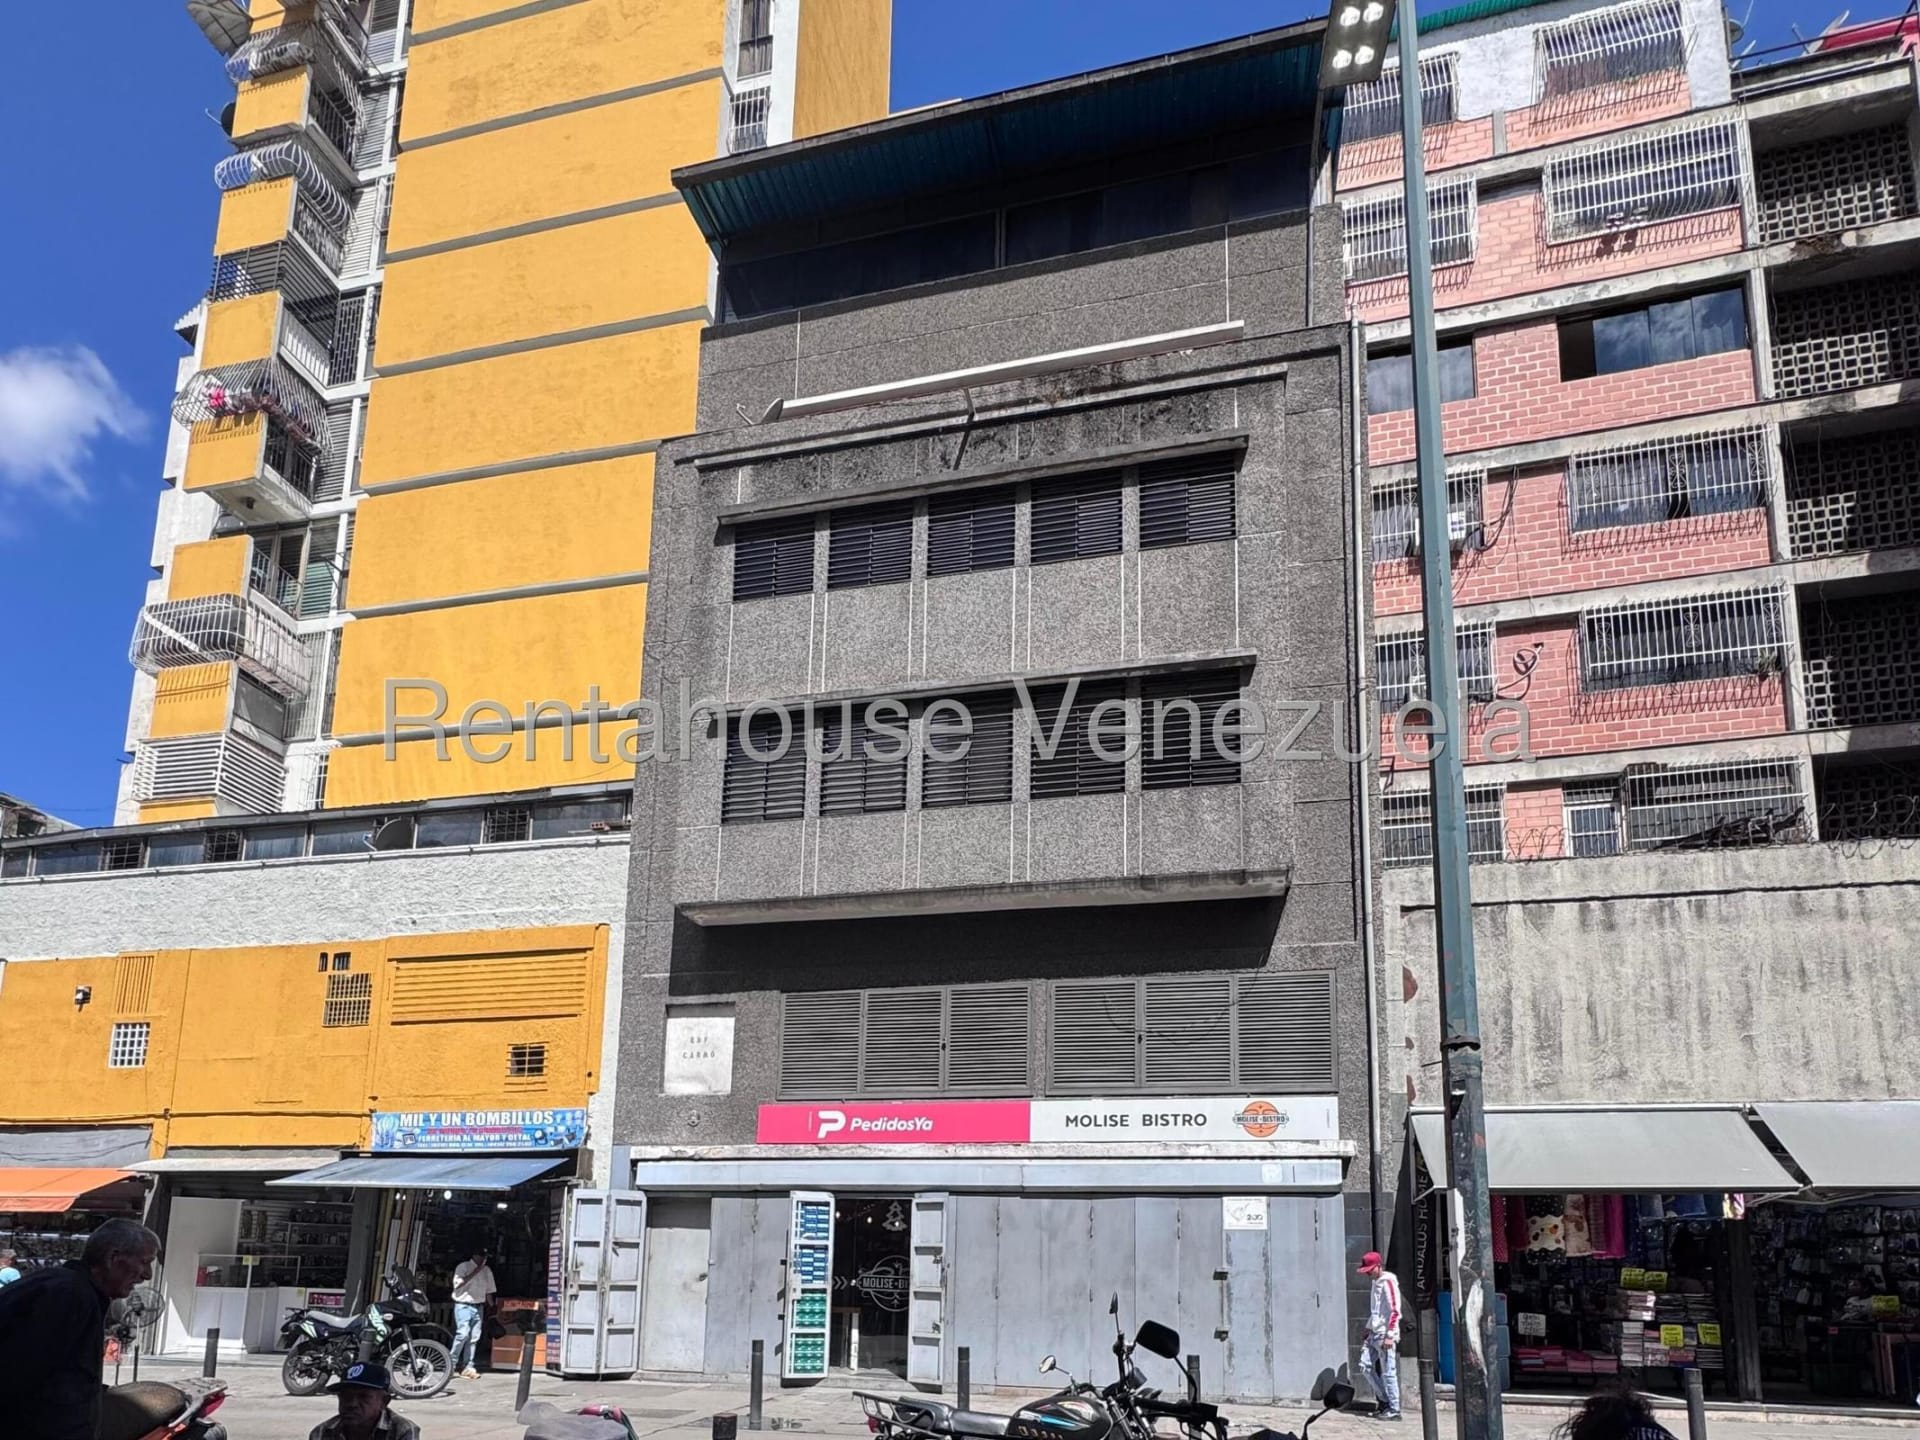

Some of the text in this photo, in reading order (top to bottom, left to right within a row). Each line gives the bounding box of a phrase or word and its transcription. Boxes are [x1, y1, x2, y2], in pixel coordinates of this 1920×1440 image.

[400, 1110, 554, 1127] MIL Y UN BOMBILLOS
[850, 1116, 933, 1132] PedidosYa
[1065, 1113, 1207, 1128] MOLISE BISTRO
[473, 1133, 500, 1141] MAYOR
[862, 1277, 893, 1289] MOLISE
